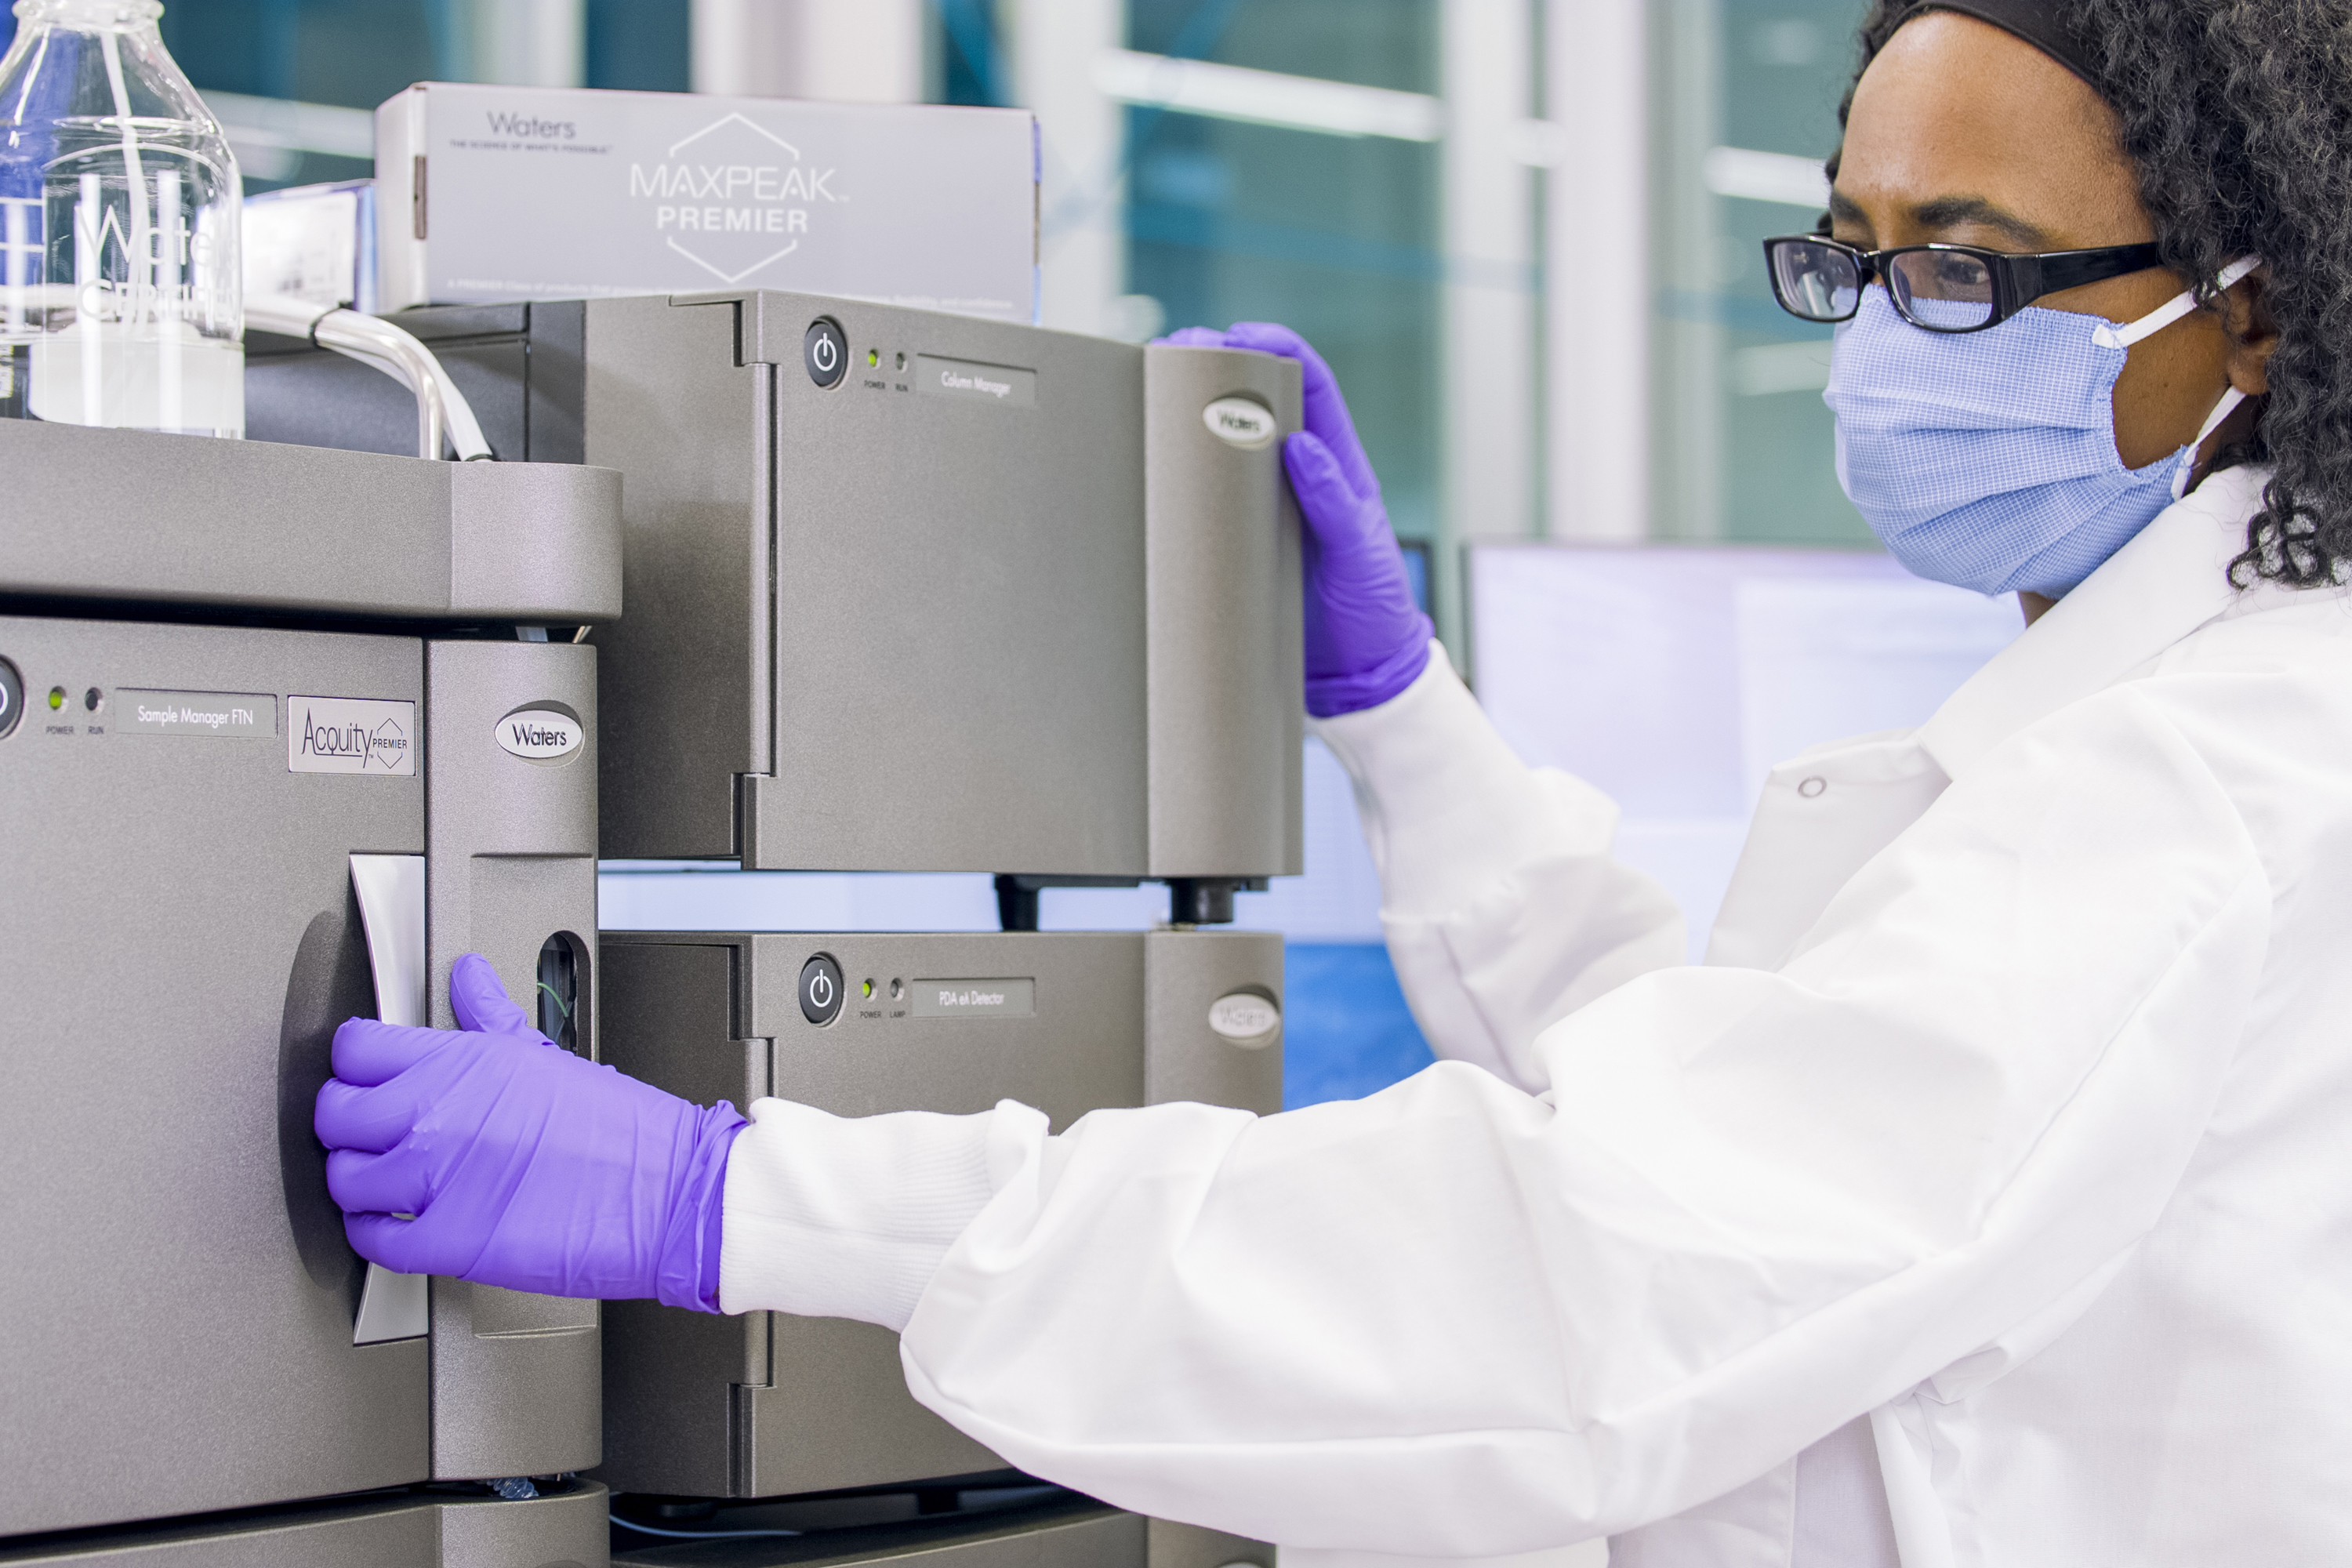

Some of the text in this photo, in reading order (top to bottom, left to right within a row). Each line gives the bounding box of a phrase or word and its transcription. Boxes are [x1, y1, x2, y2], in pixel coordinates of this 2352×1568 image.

[485, 110, 578, 140] Waters
[630, 163, 837, 201] MAXPEAK
[656, 205, 808, 233] PREMIER
[864, 380, 909, 392] POWER RUN
[941, 371, 1011, 397] Column Manager
[138, 706, 253, 728] Sample Manager FTN
[45, 726, 104, 735] POWER RUN
[301, 707, 373, 768] Acquity
[511, 722, 568, 747] Waters
[372, 738, 408, 750] PREMIER
[939, 991, 957, 1006] PDA
[971, 990, 1005, 1006] Detector
